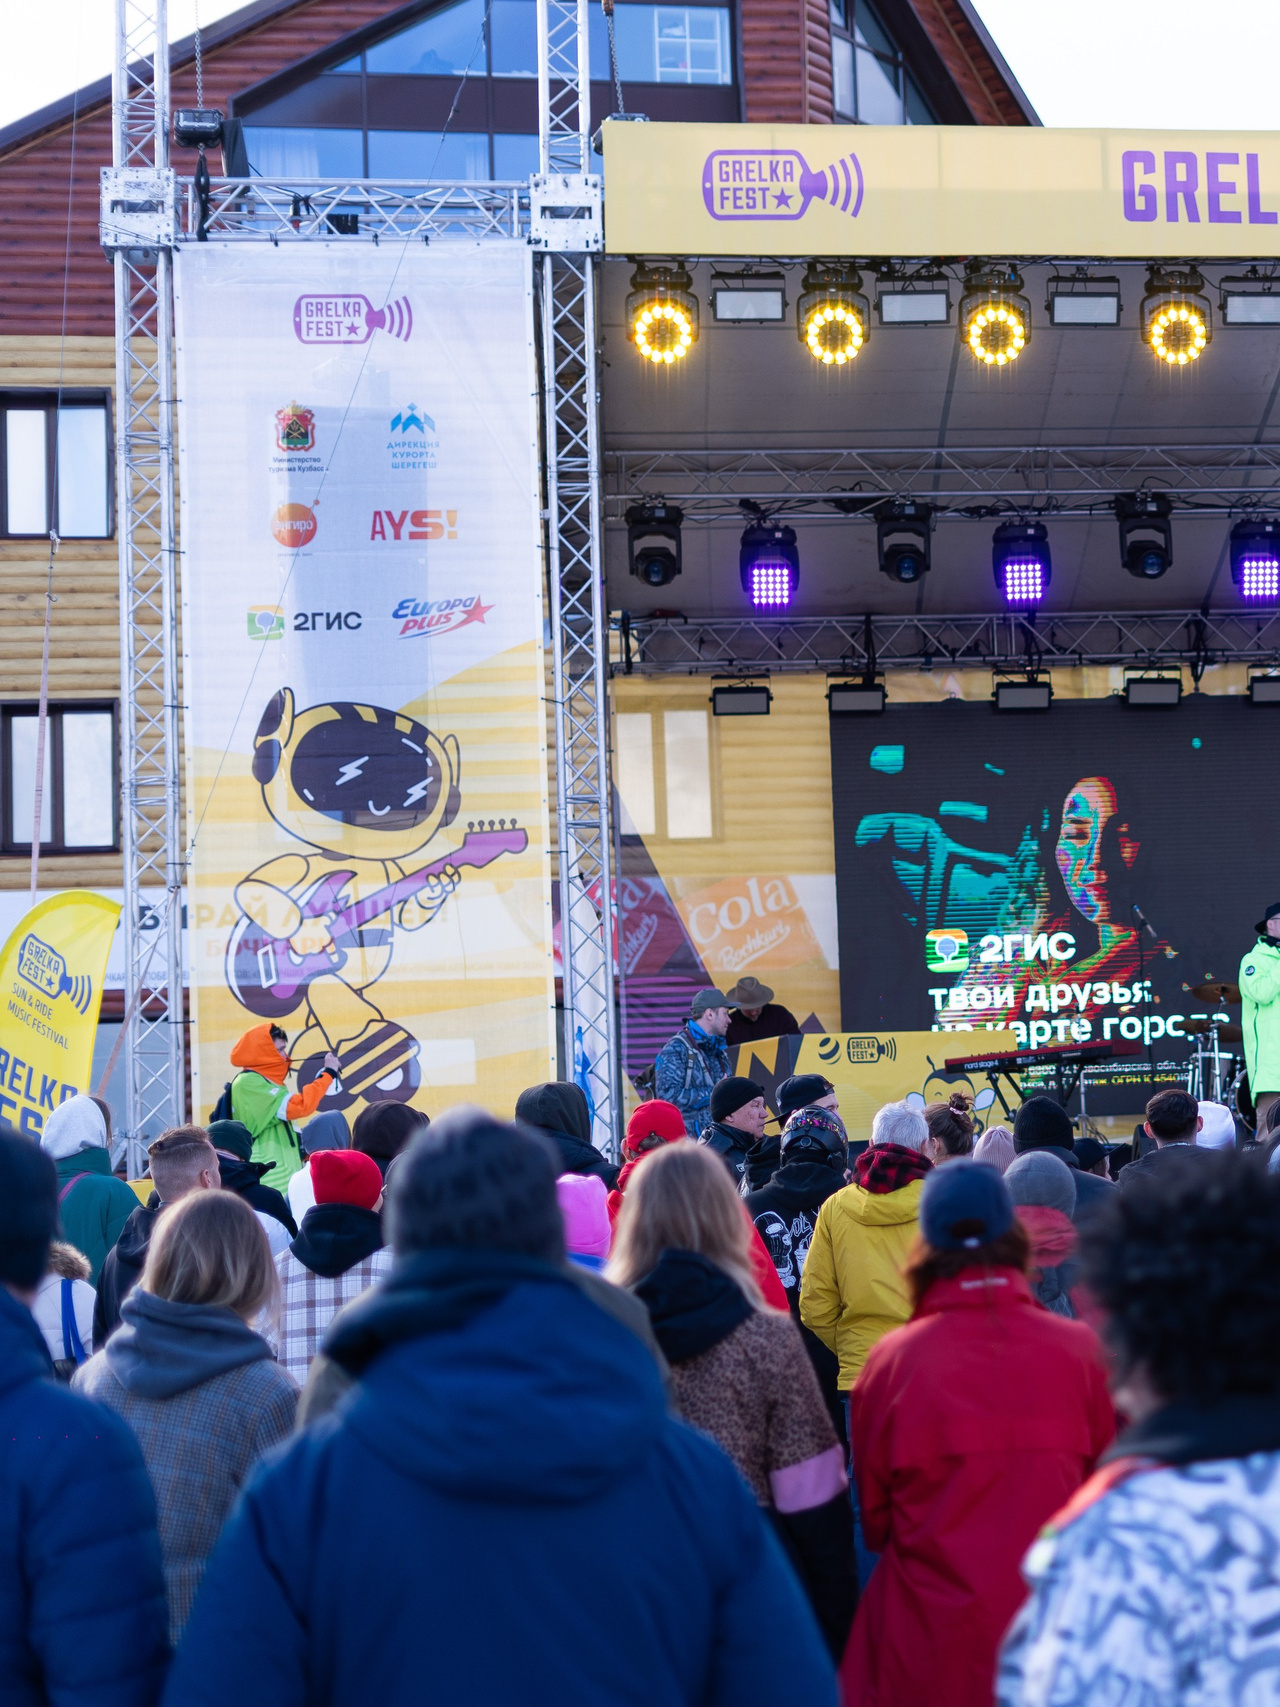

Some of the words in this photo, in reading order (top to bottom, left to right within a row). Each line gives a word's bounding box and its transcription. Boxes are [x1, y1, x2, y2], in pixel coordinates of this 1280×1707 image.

[718, 159, 794, 184] GRELKA
[720, 187, 772, 211] FEST
[305, 300, 362, 318] GRELKA
[306, 320, 344, 337] FEST
[386, 441, 440, 450] ДИРЕКЦИЯ
[392, 451, 436, 459] КУРОРТА
[391, 461, 437, 469] ШЕРЕГЕШ
[370, 510, 458, 541] AYS!
[293, 612, 363, 631] 2ГИС
[688, 877, 791, 945] Cola
[27, 940, 60, 975] GRELKA
[979, 931, 1077, 963] 2ГИС
[21, 958, 46, 985] FEST
[12, 981, 28, 1003] SUN
[34, 998, 54, 1021] RIDE
[928, 985, 1015, 1011] твои
[7, 998, 32, 1028] MUSIC
[32, 1014, 69, 1050] FESTIVAL
[985, 1018, 1092, 1050] арте
[1103, 1012, 1230, 1046] горо
[851, 1041, 875, 1050] GRELKA
[852, 1051, 868, 1060] FEST
[0, 1047, 78, 1111] RELK
